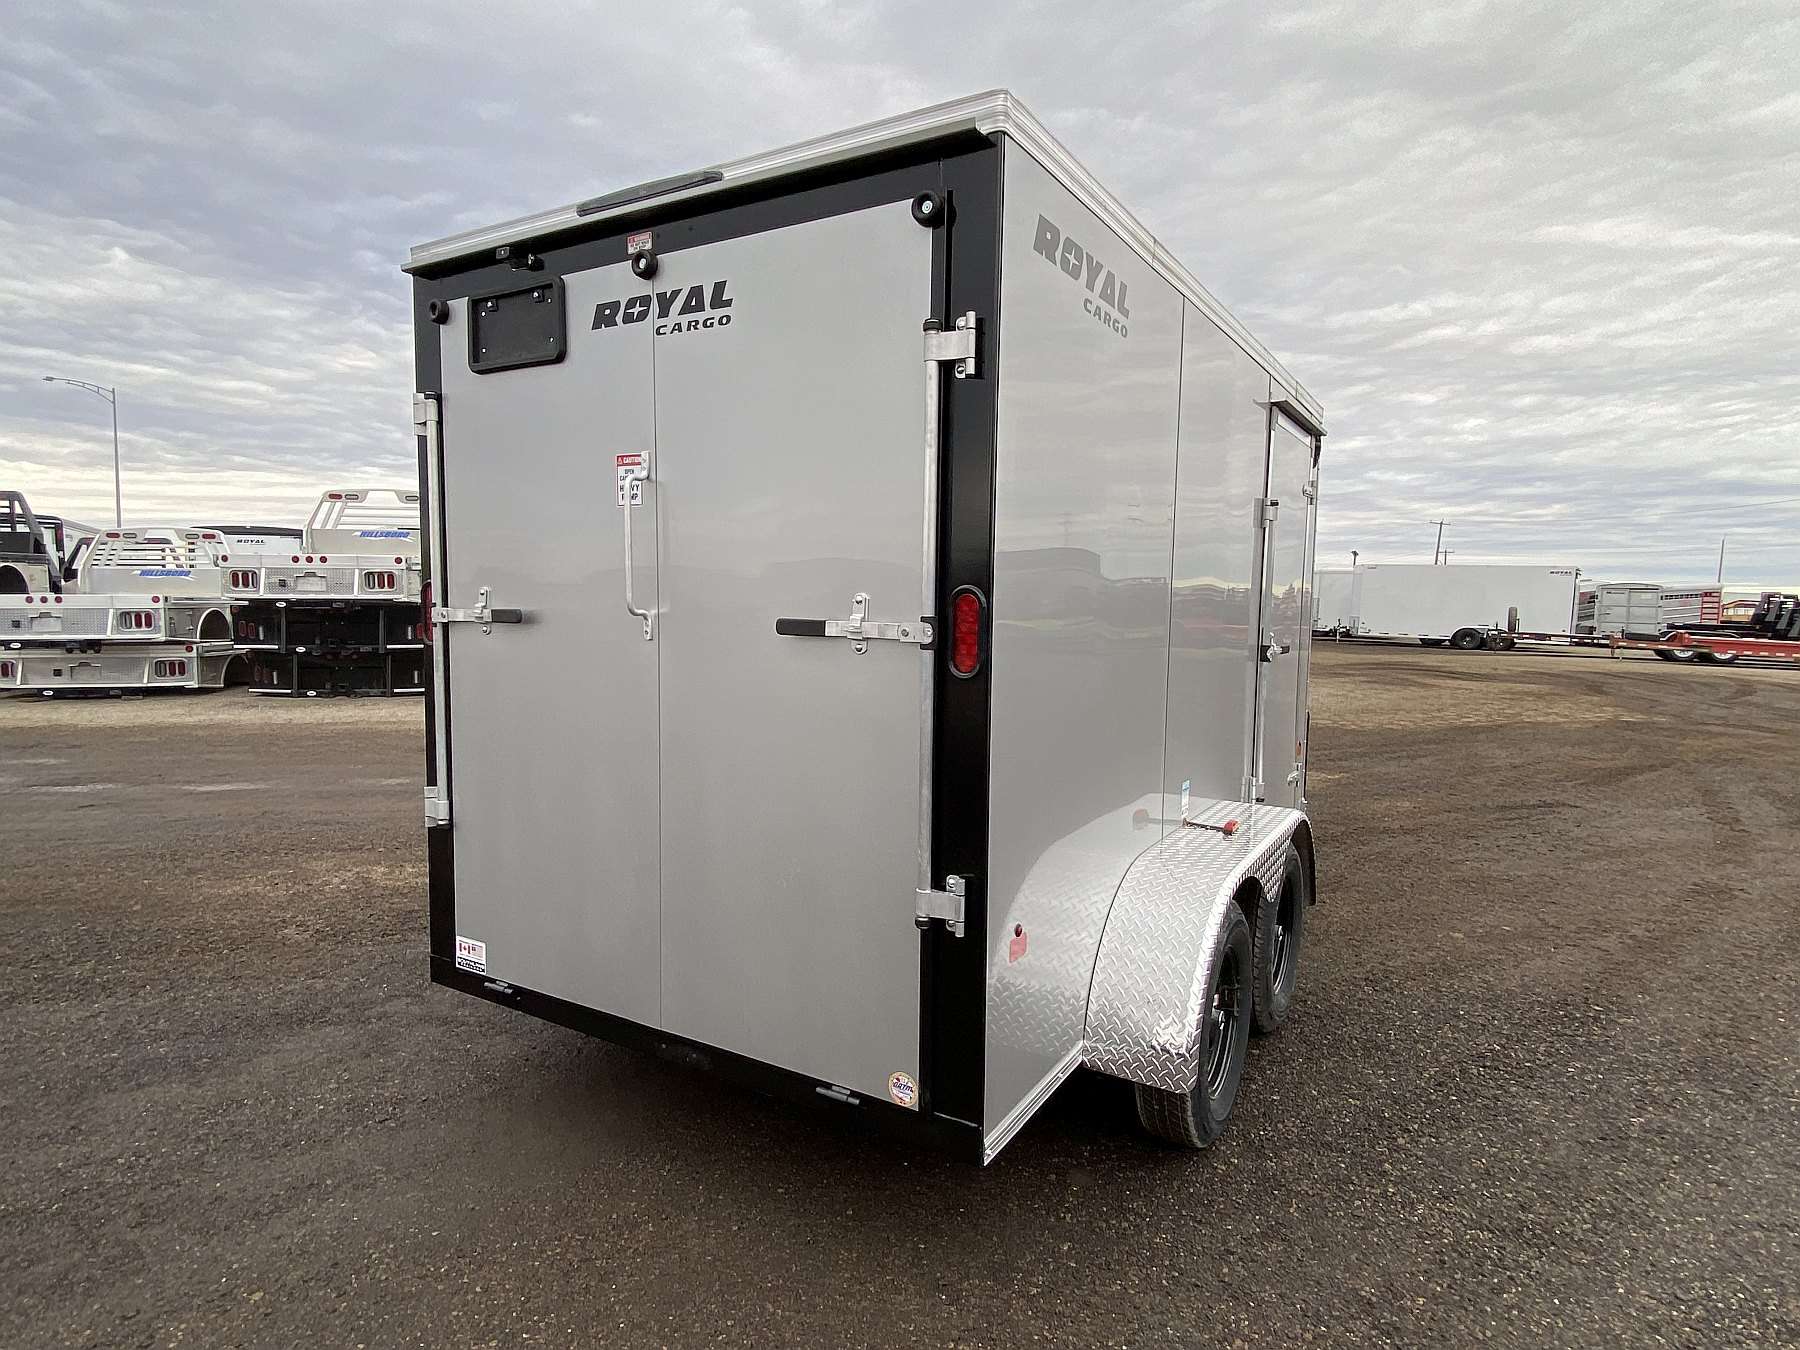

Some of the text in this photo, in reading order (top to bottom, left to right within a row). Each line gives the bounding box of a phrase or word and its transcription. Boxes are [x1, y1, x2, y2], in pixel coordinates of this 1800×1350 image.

[1033, 214, 1130, 320] ROYAL
[591, 280, 733, 331] ROYAL
[655, 314, 732, 336] CARGO
[1083, 298, 1128, 338] CARGO
[619, 484, 640, 492] HVY
[360, 530, 410, 538] HILLSBORO
[139, 569, 192, 577] HILLSBORO
